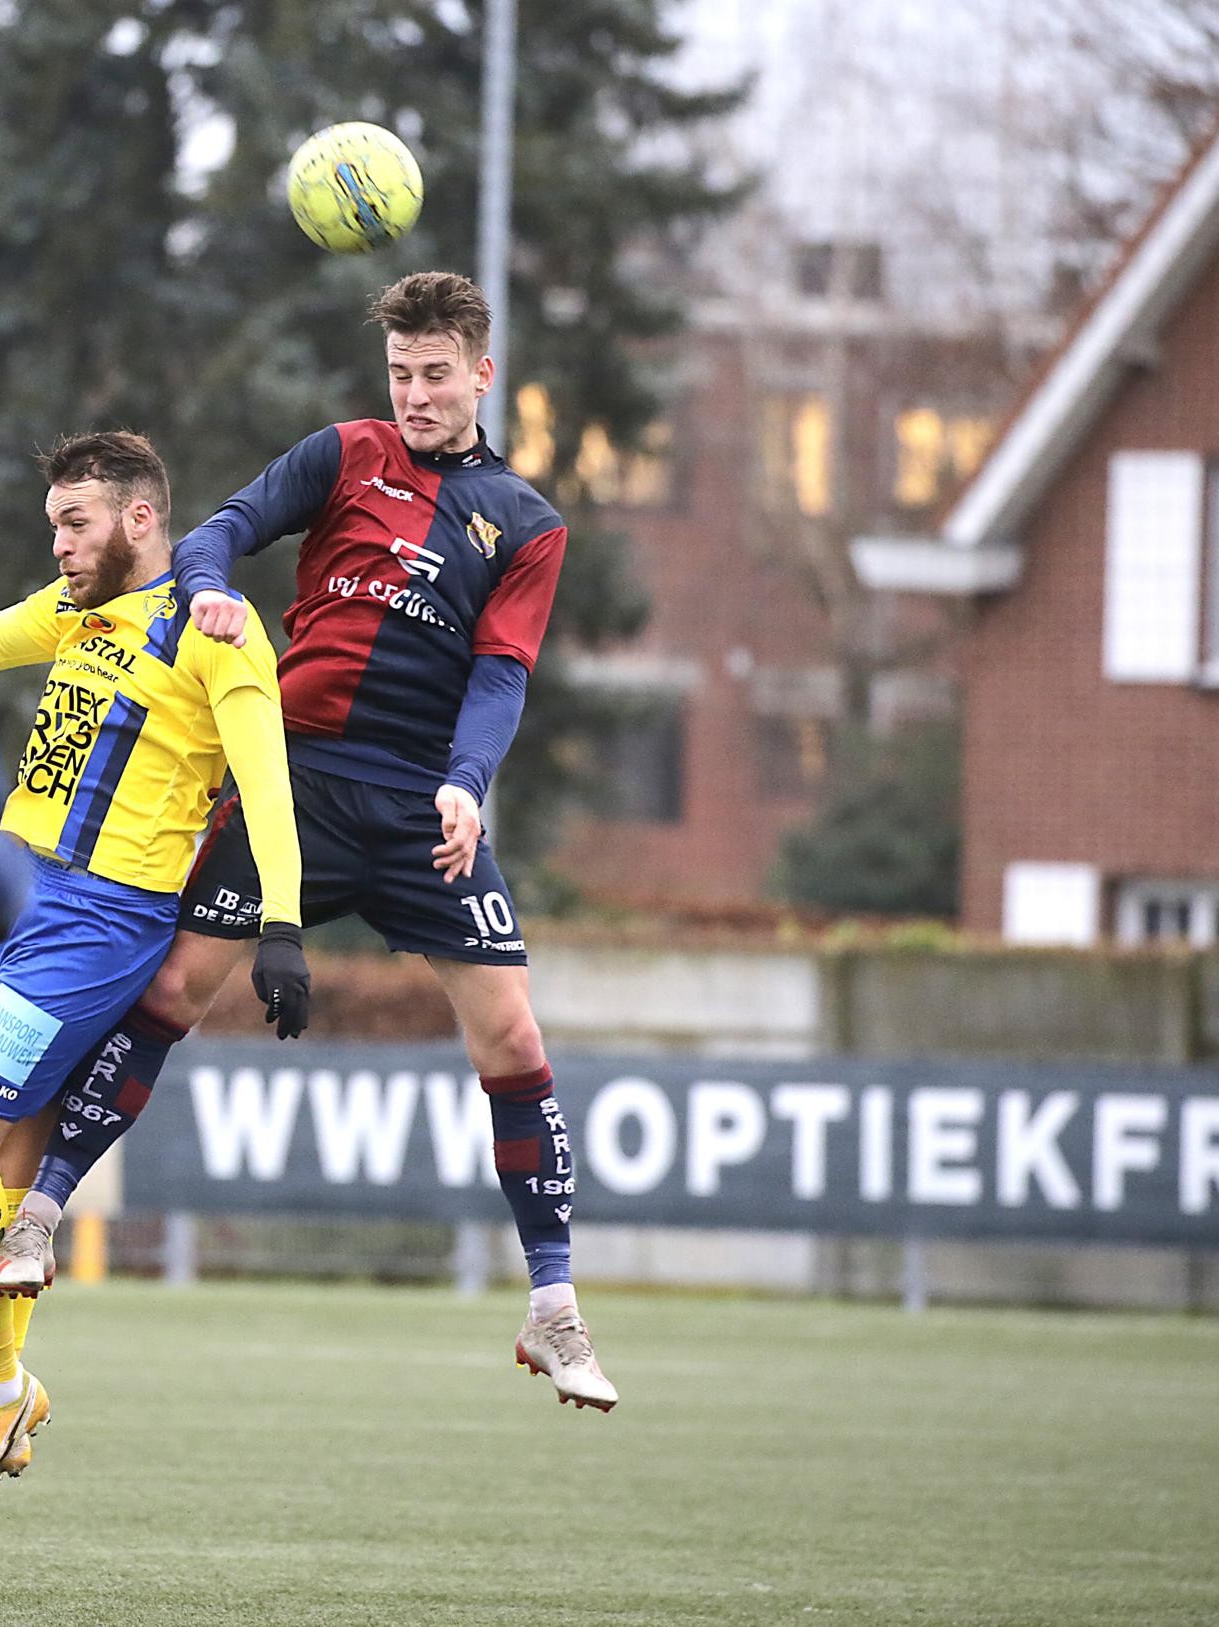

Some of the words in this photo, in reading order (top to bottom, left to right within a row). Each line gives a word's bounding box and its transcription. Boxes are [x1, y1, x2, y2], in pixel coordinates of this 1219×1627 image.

[97, 665, 119, 683] hear
[214, 888, 240, 911] DB
[461, 891, 514, 937] 10
